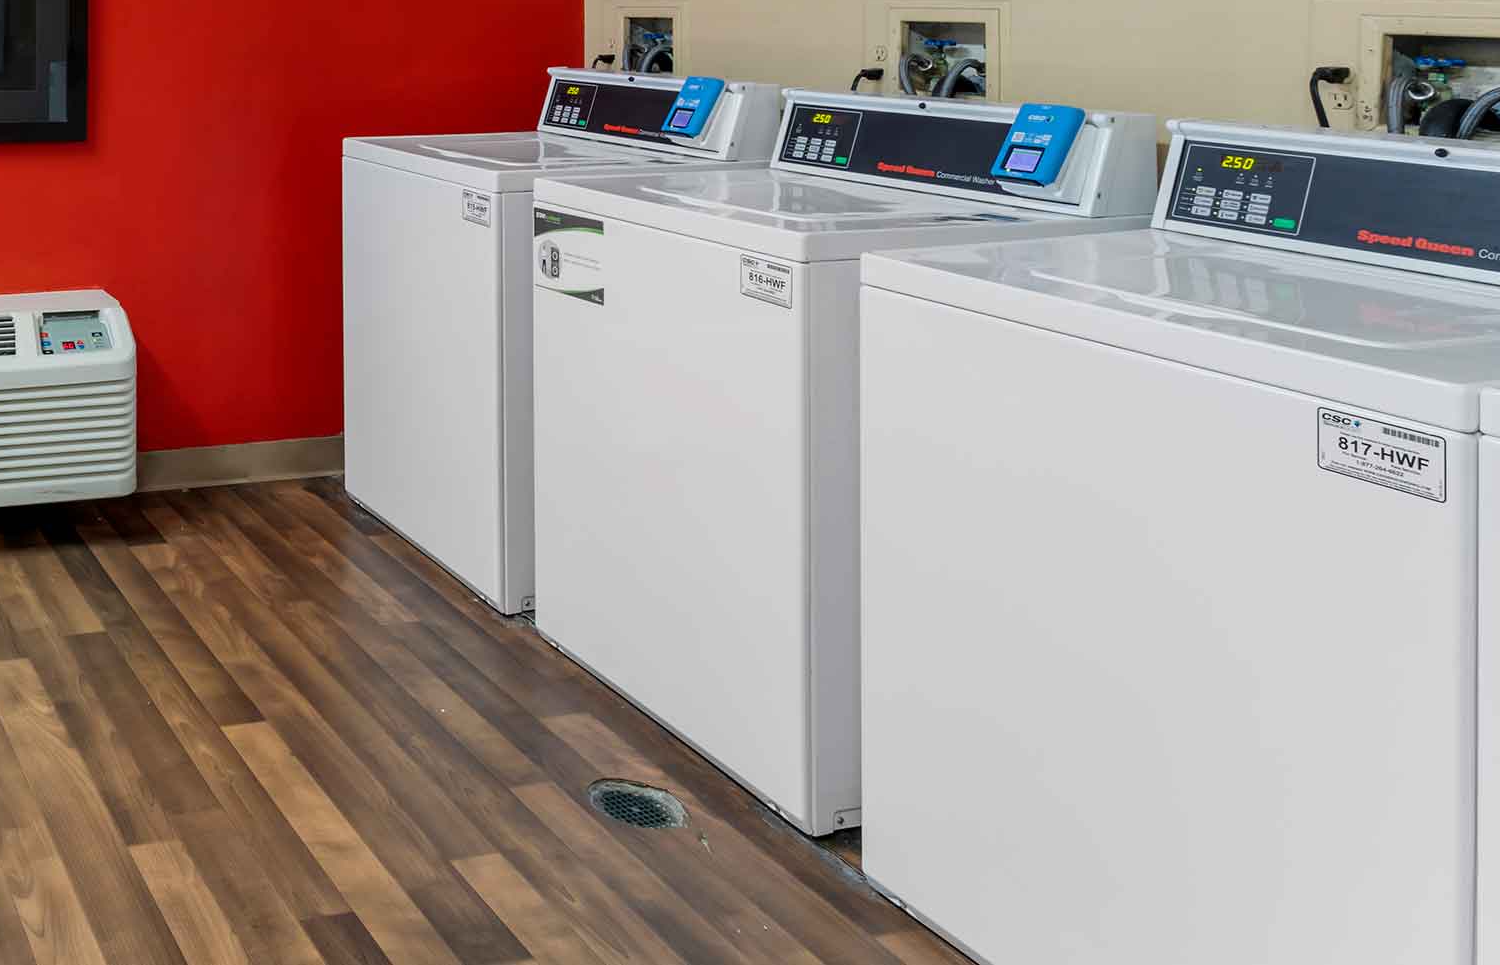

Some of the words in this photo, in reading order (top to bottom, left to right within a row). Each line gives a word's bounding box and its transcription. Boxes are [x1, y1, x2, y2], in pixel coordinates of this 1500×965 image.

[1357, 229, 1413, 247] Speed
[1415, 237, 1475, 257] Queen
[749, 272, 786, 290] 816-HWF
[1322, 412, 1352, 426] CSC
[1338, 436, 1430, 471] 817-HWF
